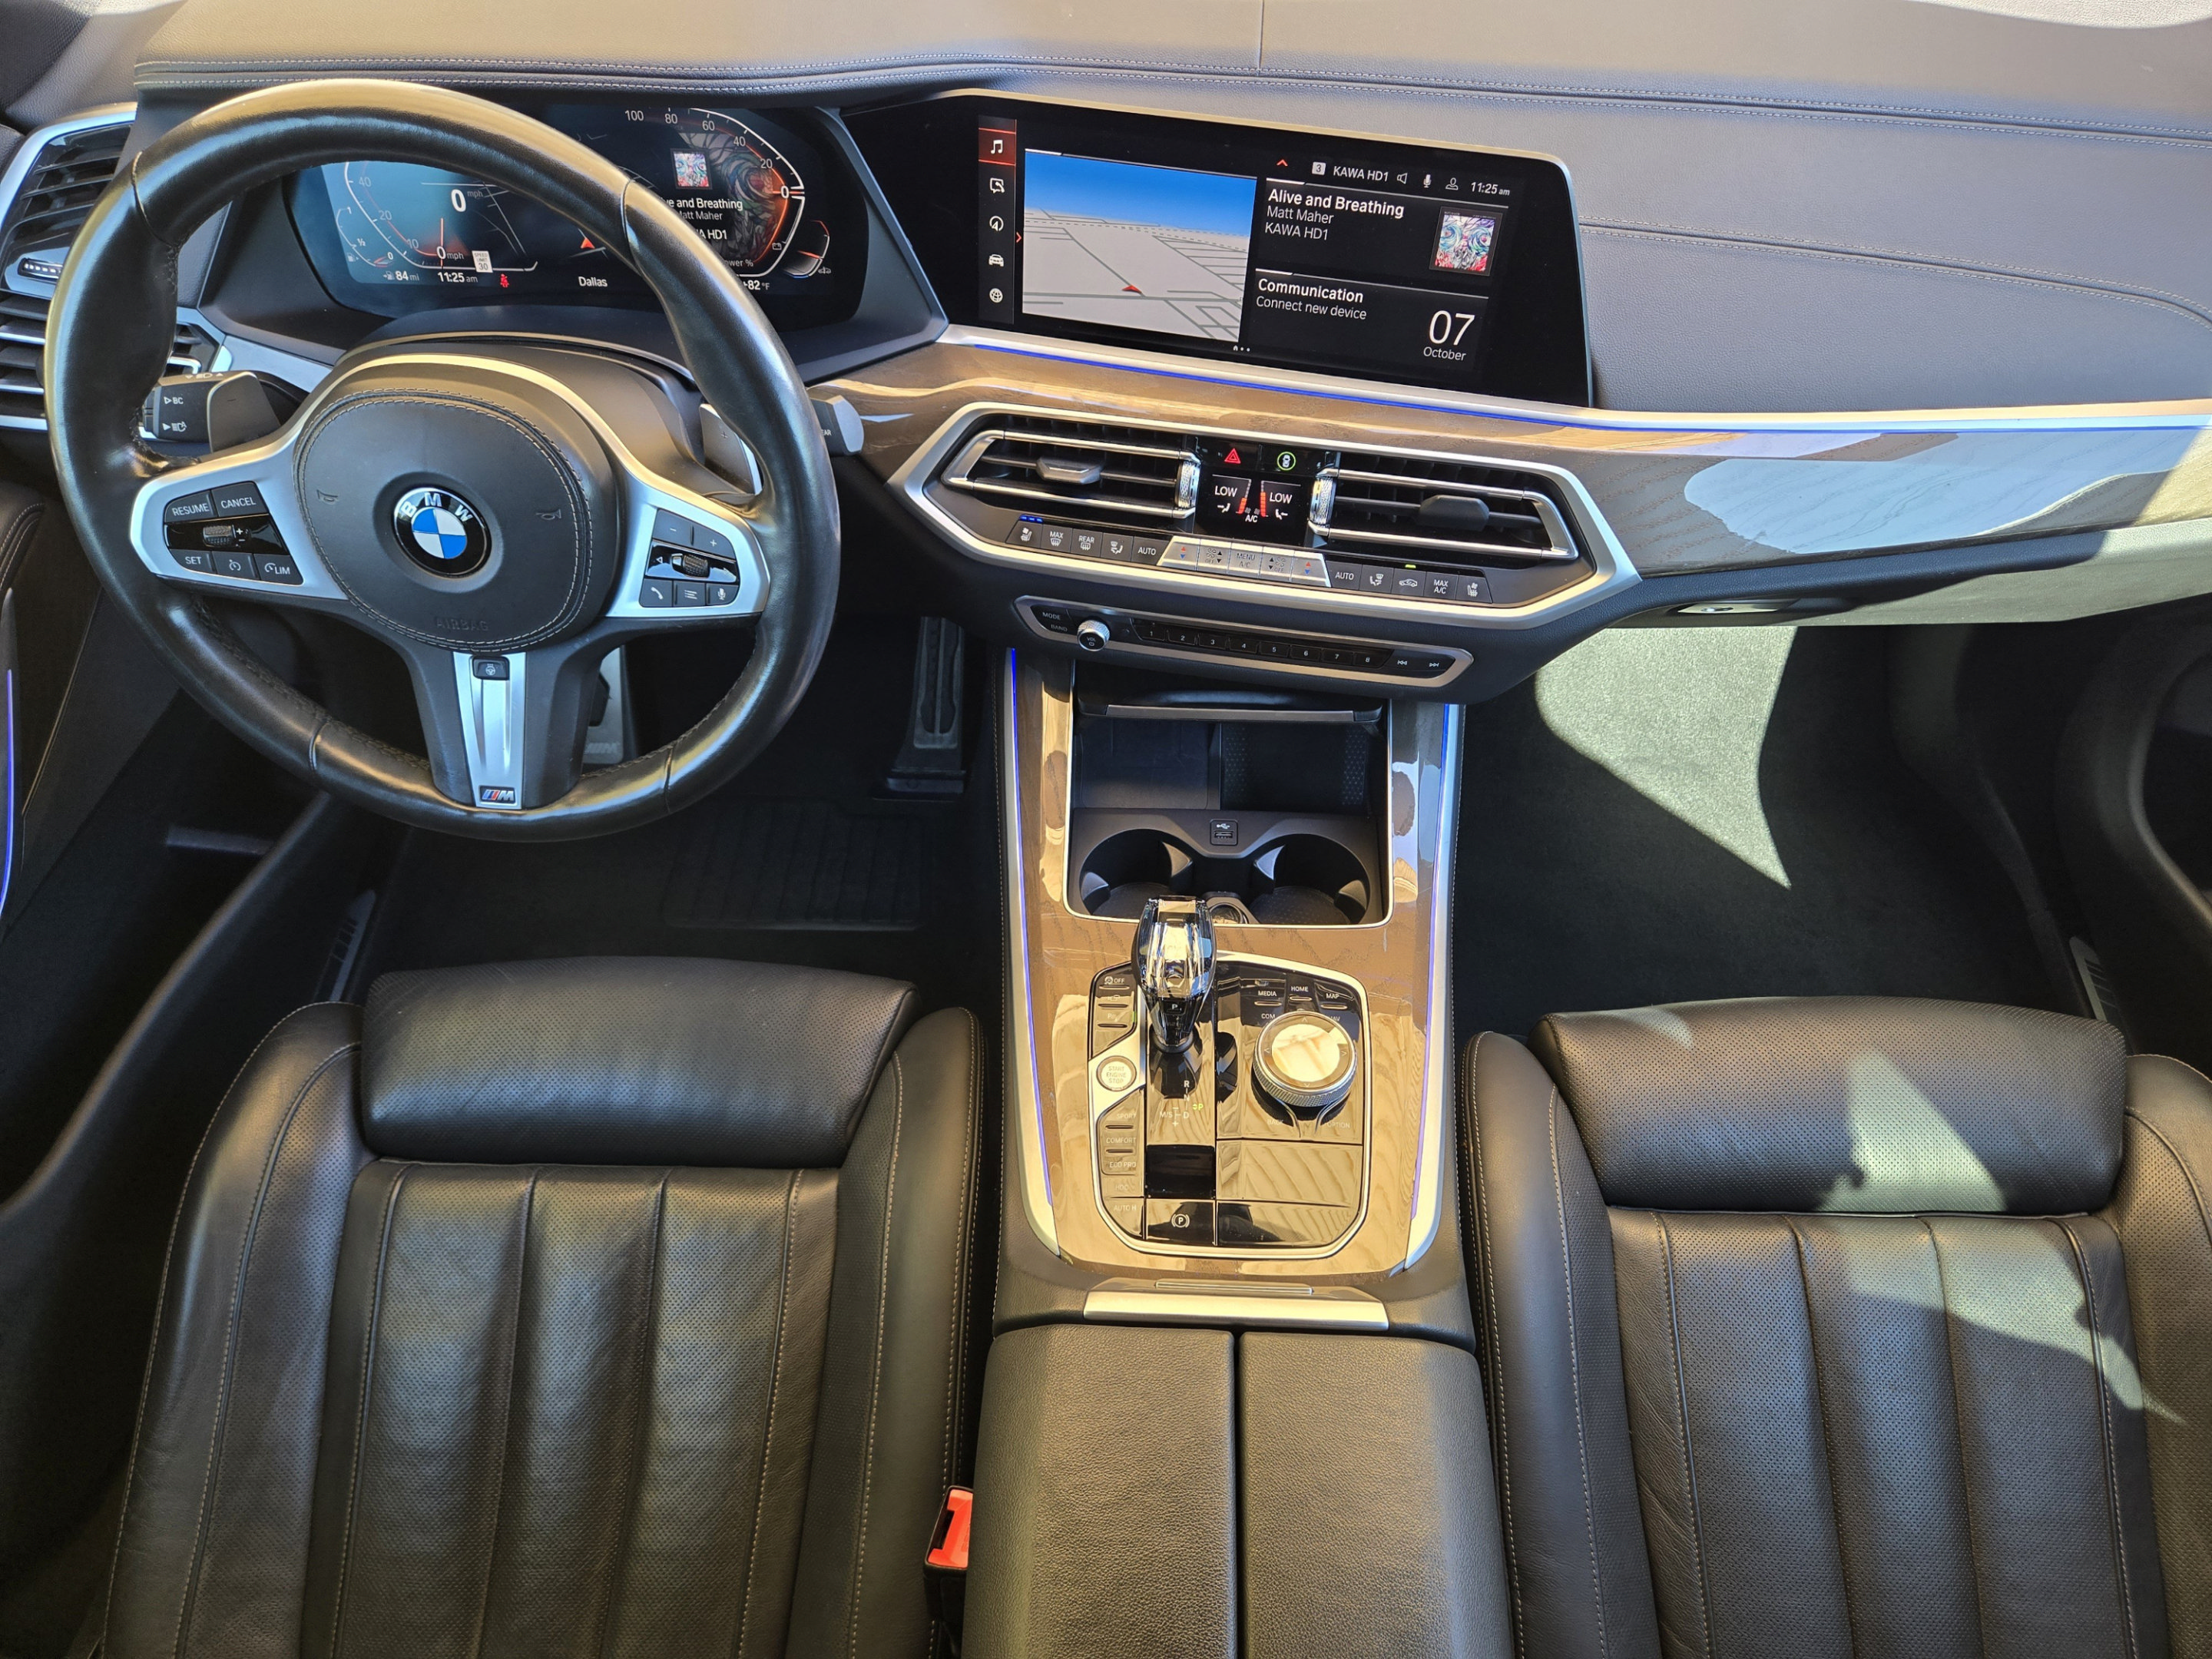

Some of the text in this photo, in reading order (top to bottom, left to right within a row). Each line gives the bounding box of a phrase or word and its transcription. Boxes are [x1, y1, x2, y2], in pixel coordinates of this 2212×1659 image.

[625, 110, 644, 121] 100
[665, 114, 677, 124] 80
[702, 120, 715, 131] 60
[733, 136, 746, 147] 40
[760, 158, 773, 170] 20
[1315, 164, 1321, 173] 3
[1333, 165, 1389, 183] KAWA HD1
[359, 177, 371, 187] 40
[1471, 181, 1498, 194] 11:25
[780, 185, 789, 198] 0
[451, 189, 483, 212] 0 mph
[677, 197, 695, 207] and
[696, 197, 743, 210] Breathing
[1268, 189, 1405, 219] Alive and Breathing
[379, 210, 392, 220] 20
[695, 210, 723, 220] Maher
[1267, 206, 1334, 224] Matt Maher
[707, 229, 727, 240] HD1
[1265, 222, 1328, 240] KAWA HD1
[408, 239, 419, 250] 10
[437, 247, 464, 260] 0 mph
[395, 271, 409, 281] 84
[438, 272, 465, 283] 11:25
[578, 276, 608, 286] Dallas
[1258, 278, 1363, 303] Communication
[1256, 296, 1367, 320] Connect new device
[1429, 310, 1475, 346] 07
[1423, 346, 1466, 361] October
[1214, 485, 1237, 498] LOW
[220, 497, 257, 508] CANCEL
[1269, 492, 1292, 504] LOW
[172, 503, 210, 516] RESUME
[401, 492, 473, 522] BMW
[1245, 514, 1258, 523] A/C
[1049, 531, 1064, 539] MAX
[1078, 535, 1094, 544] REAR
[1137, 546, 1157, 555] AUTO
[185, 556, 202, 565] SET
[1237, 552, 1256, 561] MENU
[274, 566, 290, 575] LIM
[1335, 571, 1354, 581] AUTO
[1434, 586, 1446, 594] A/C
[1041, 611, 1061, 621] MODE
[435, 618, 489, 632] AIRBAG
[1051, 624, 1068, 633] BAND
[1184, 1094, 1190, 1102] N
